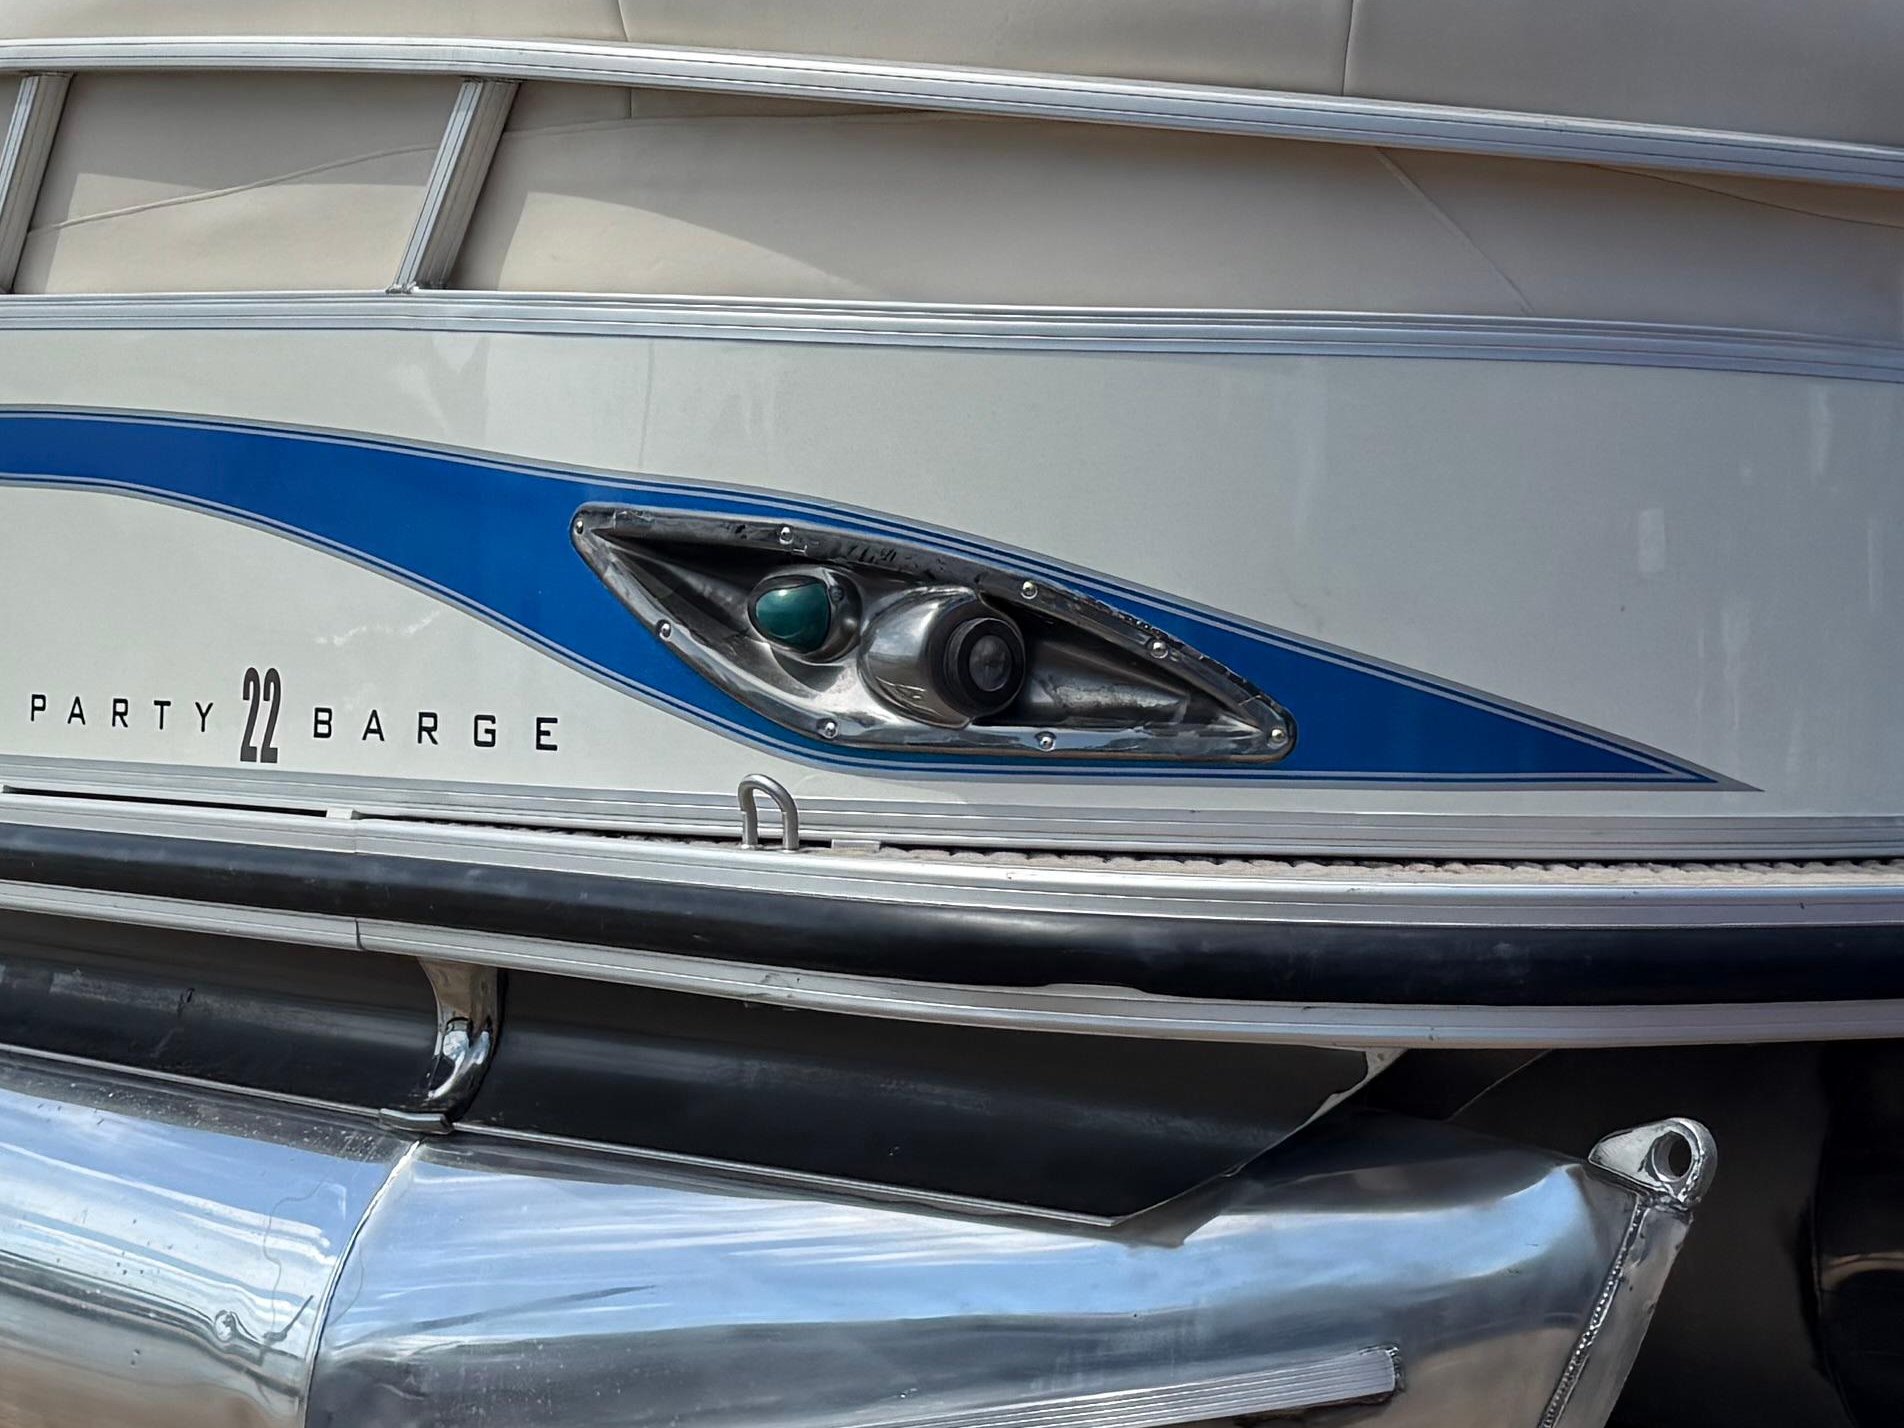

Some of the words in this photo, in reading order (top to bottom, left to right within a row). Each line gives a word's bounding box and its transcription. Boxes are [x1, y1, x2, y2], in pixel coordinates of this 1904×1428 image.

[30, 693, 214, 733] PARTY
[239, 667, 282, 764] 22
[312, 706, 559, 751] BARGE
